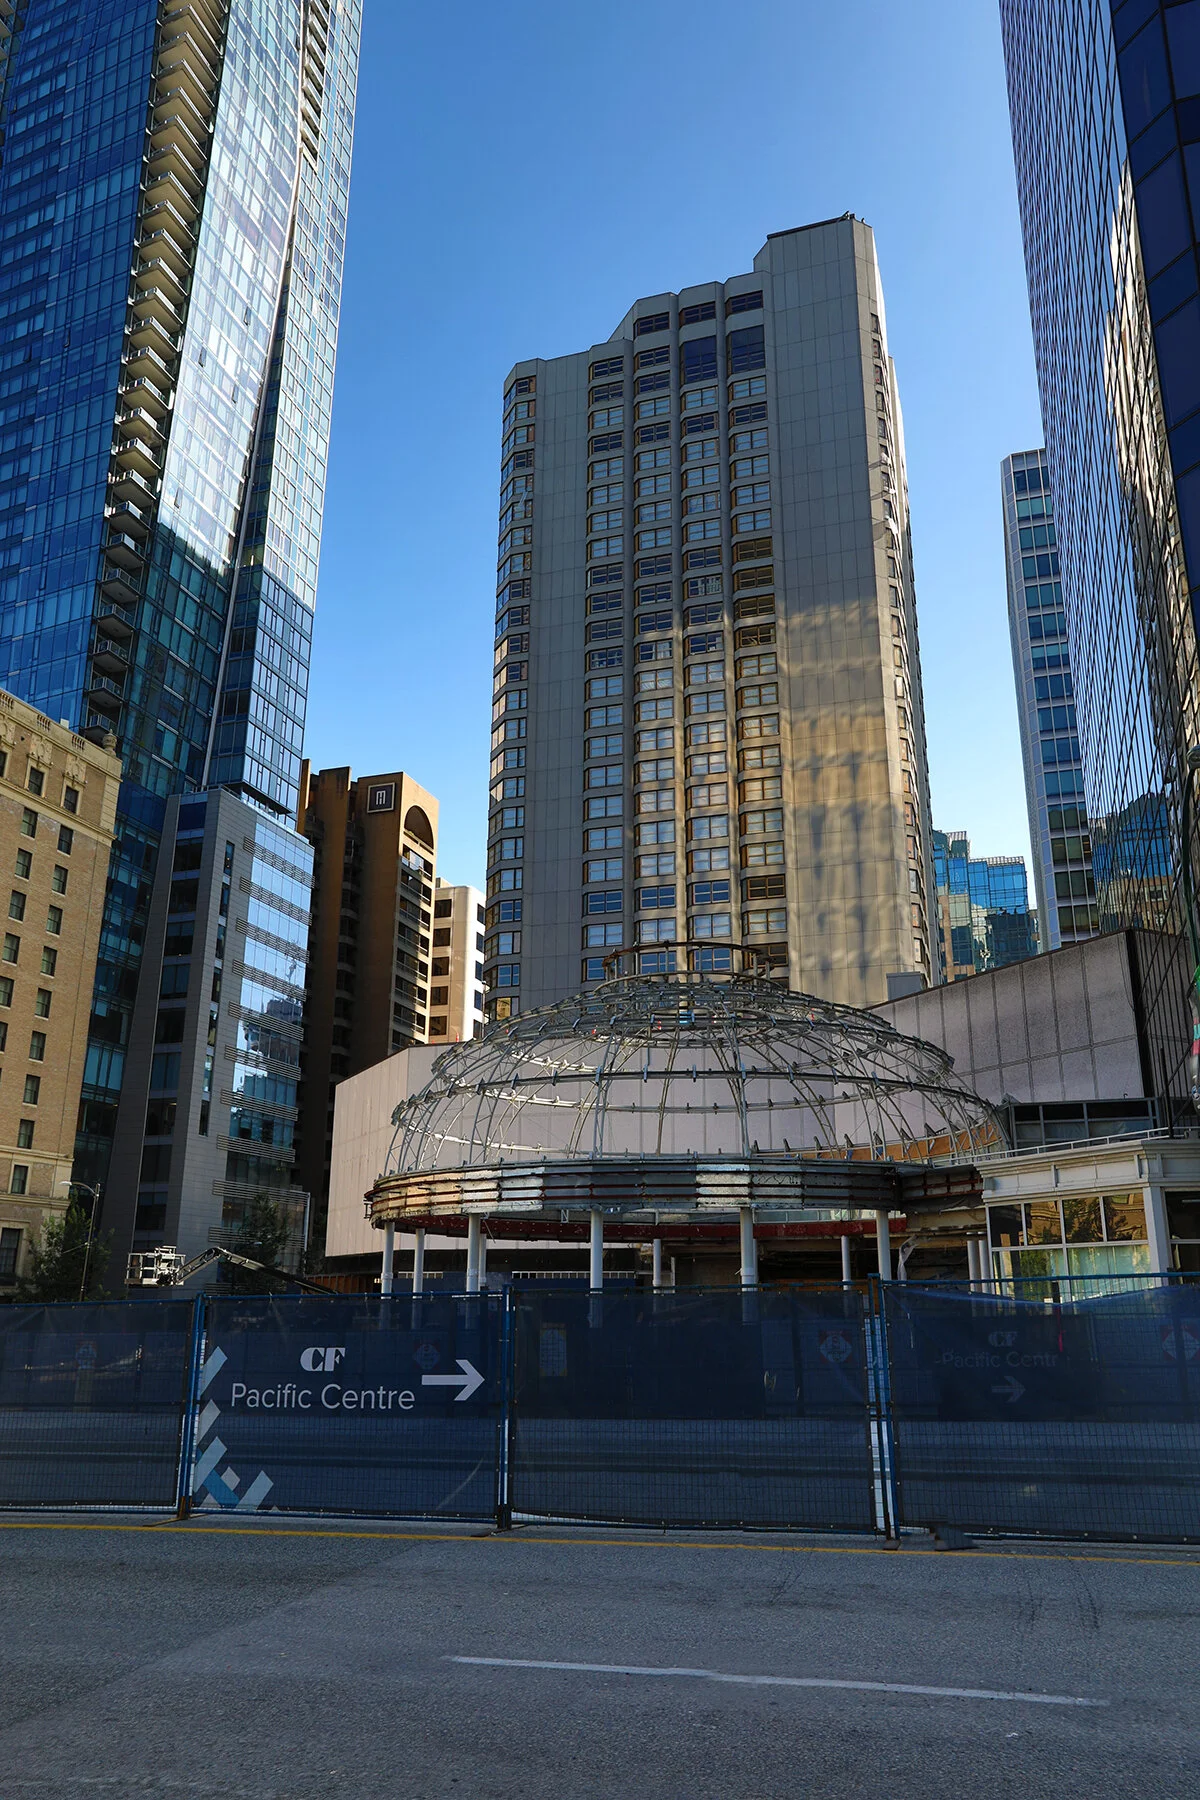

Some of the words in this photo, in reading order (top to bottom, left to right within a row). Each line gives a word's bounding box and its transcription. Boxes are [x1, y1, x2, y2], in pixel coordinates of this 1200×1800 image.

[988, 1331, 1018, 1347] CF
[300, 1347, 346, 1372] CF
[942, 1351, 1001, 1369] Pacific
[1006, 1351, 1062, 1368] Centr
[231, 1382, 312, 1409] Pacific
[321, 1383, 415, 1410] Centre
